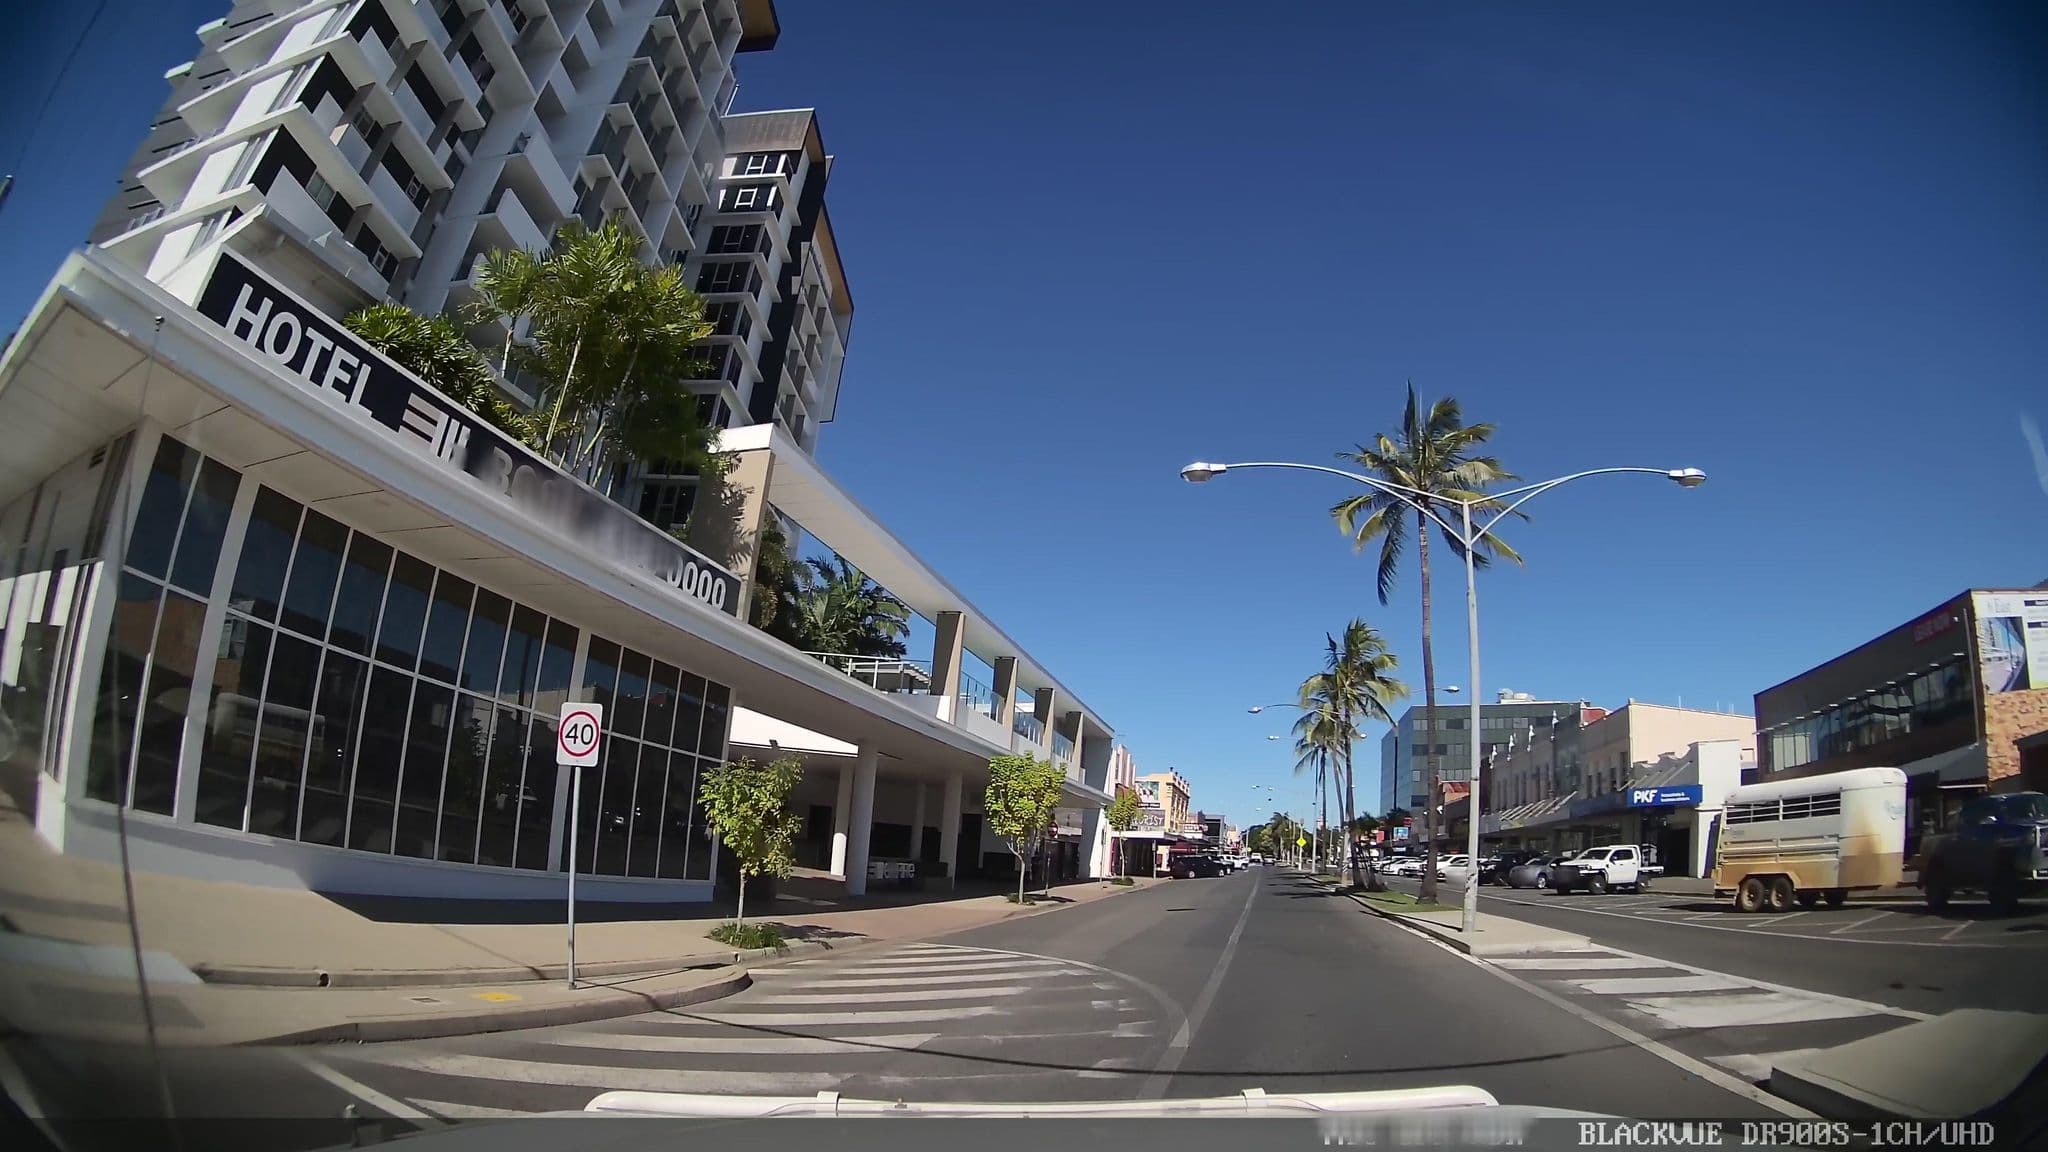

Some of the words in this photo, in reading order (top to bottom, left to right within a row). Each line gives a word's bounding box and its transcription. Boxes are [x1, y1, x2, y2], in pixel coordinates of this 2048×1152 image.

[225, 283, 373, 418] HOTEL
[565, 723, 594, 745] 40
[1633, 789, 1658, 804] PKF
